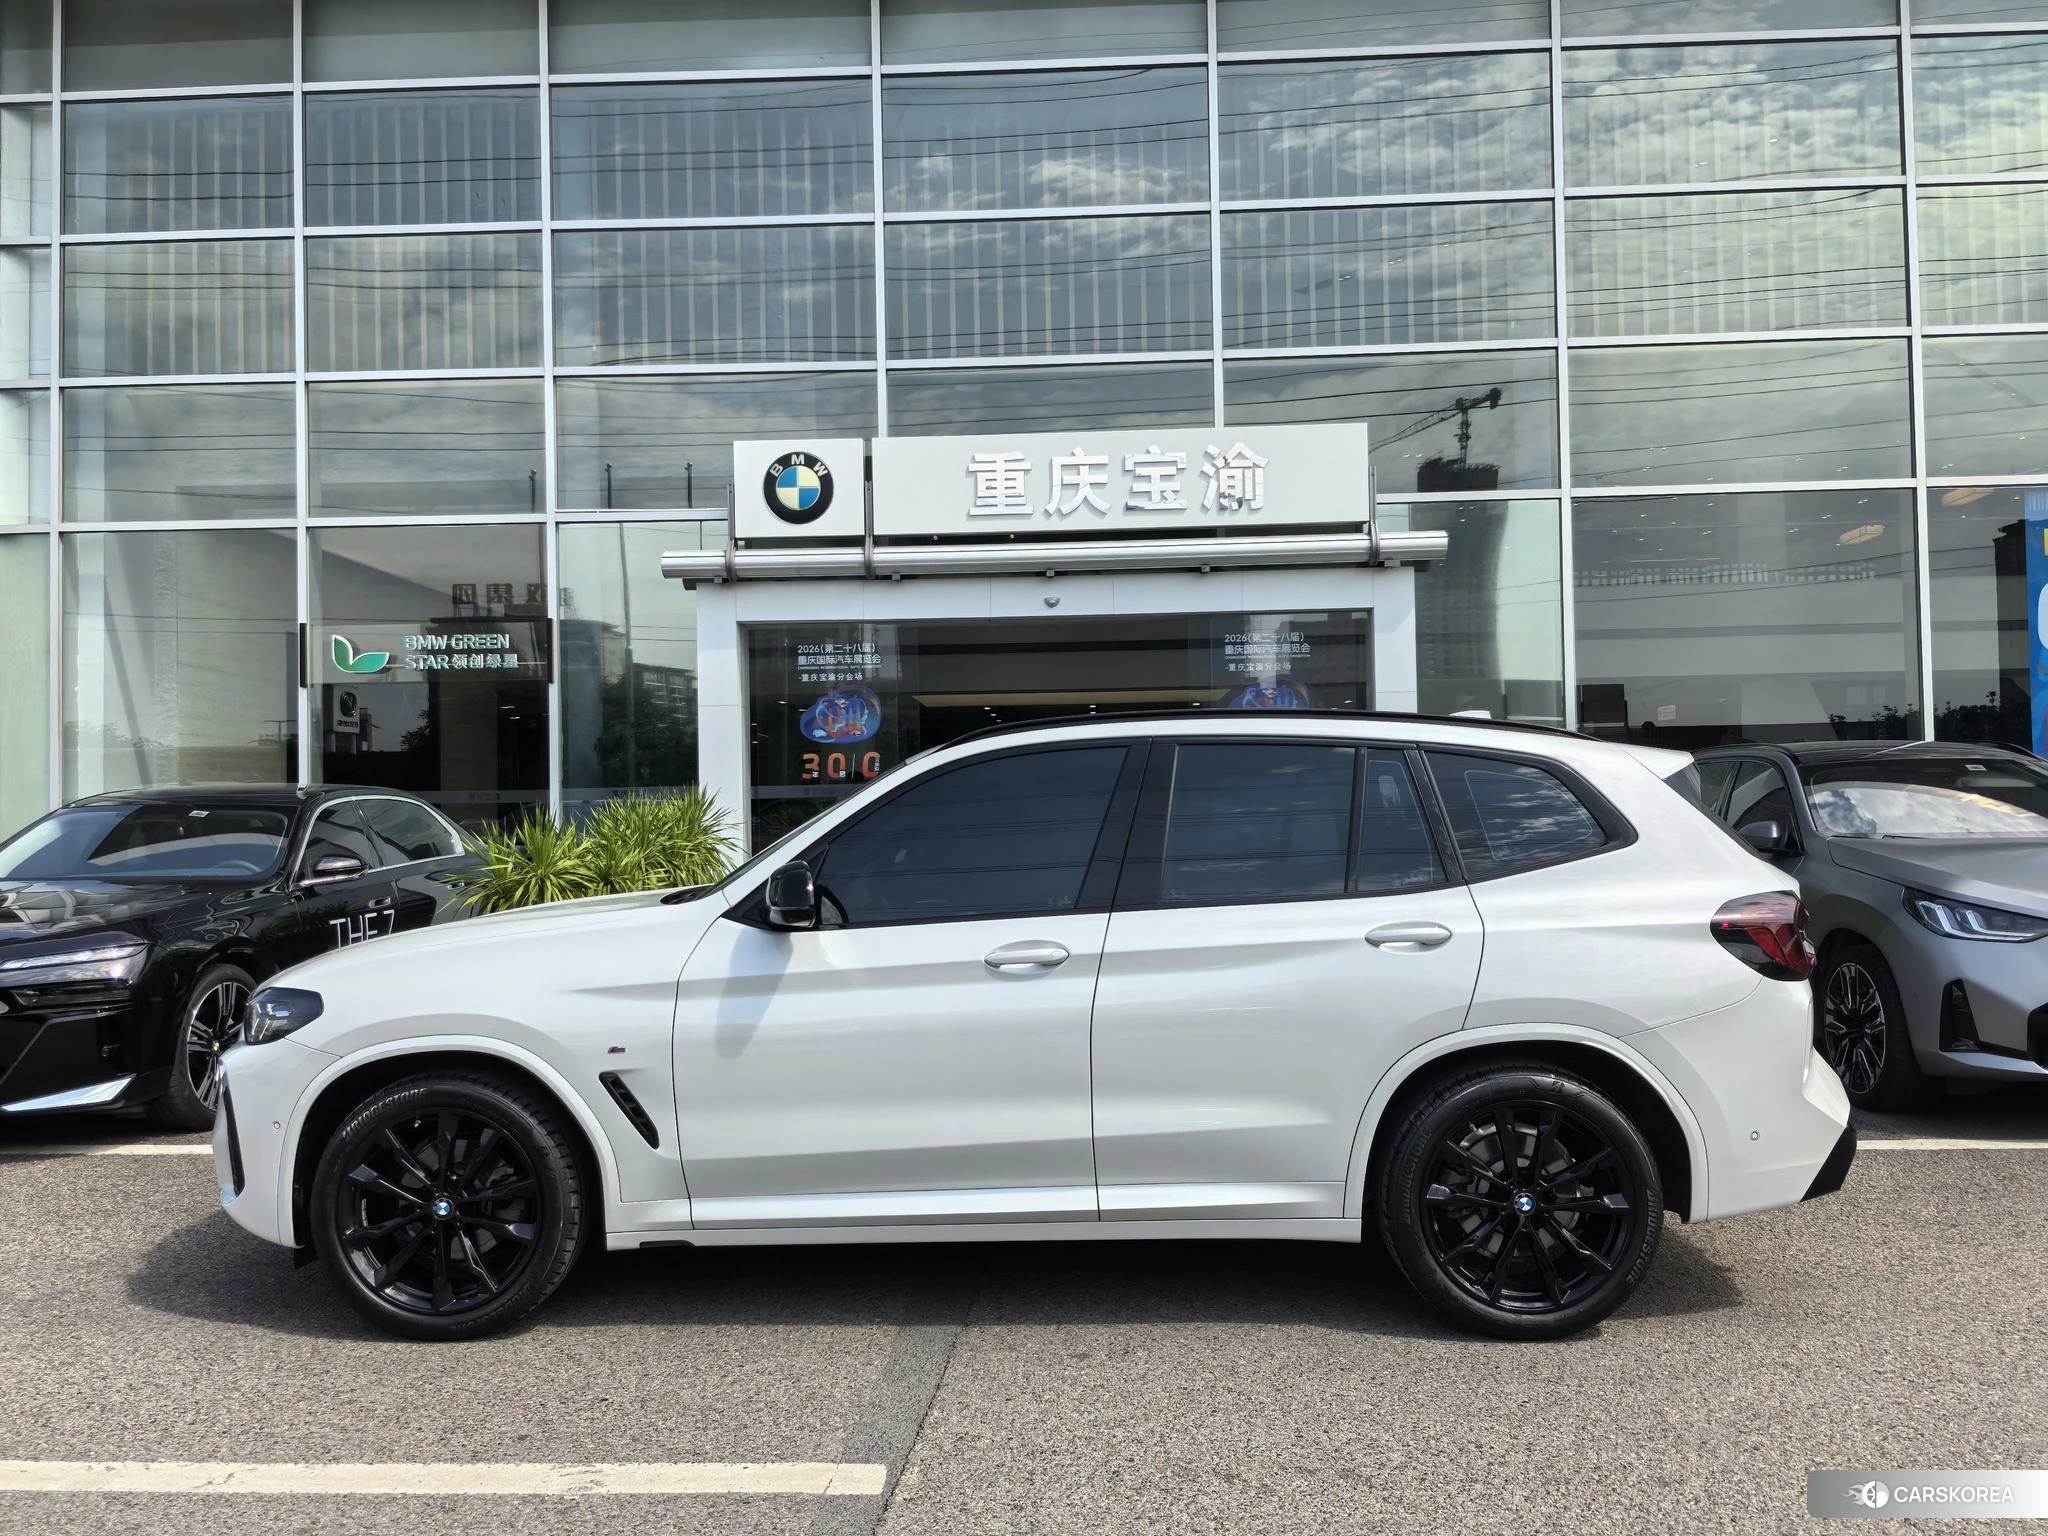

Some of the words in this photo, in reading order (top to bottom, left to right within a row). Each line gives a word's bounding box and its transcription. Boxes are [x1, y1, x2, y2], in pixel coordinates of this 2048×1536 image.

[769, 453, 829, 478] BMW
[967, 443, 1268, 517] 重庆宝渝
[404, 635, 448, 650] BMW
[452, 634, 509, 649] GREEN
[405, 654, 449, 670] STAR
